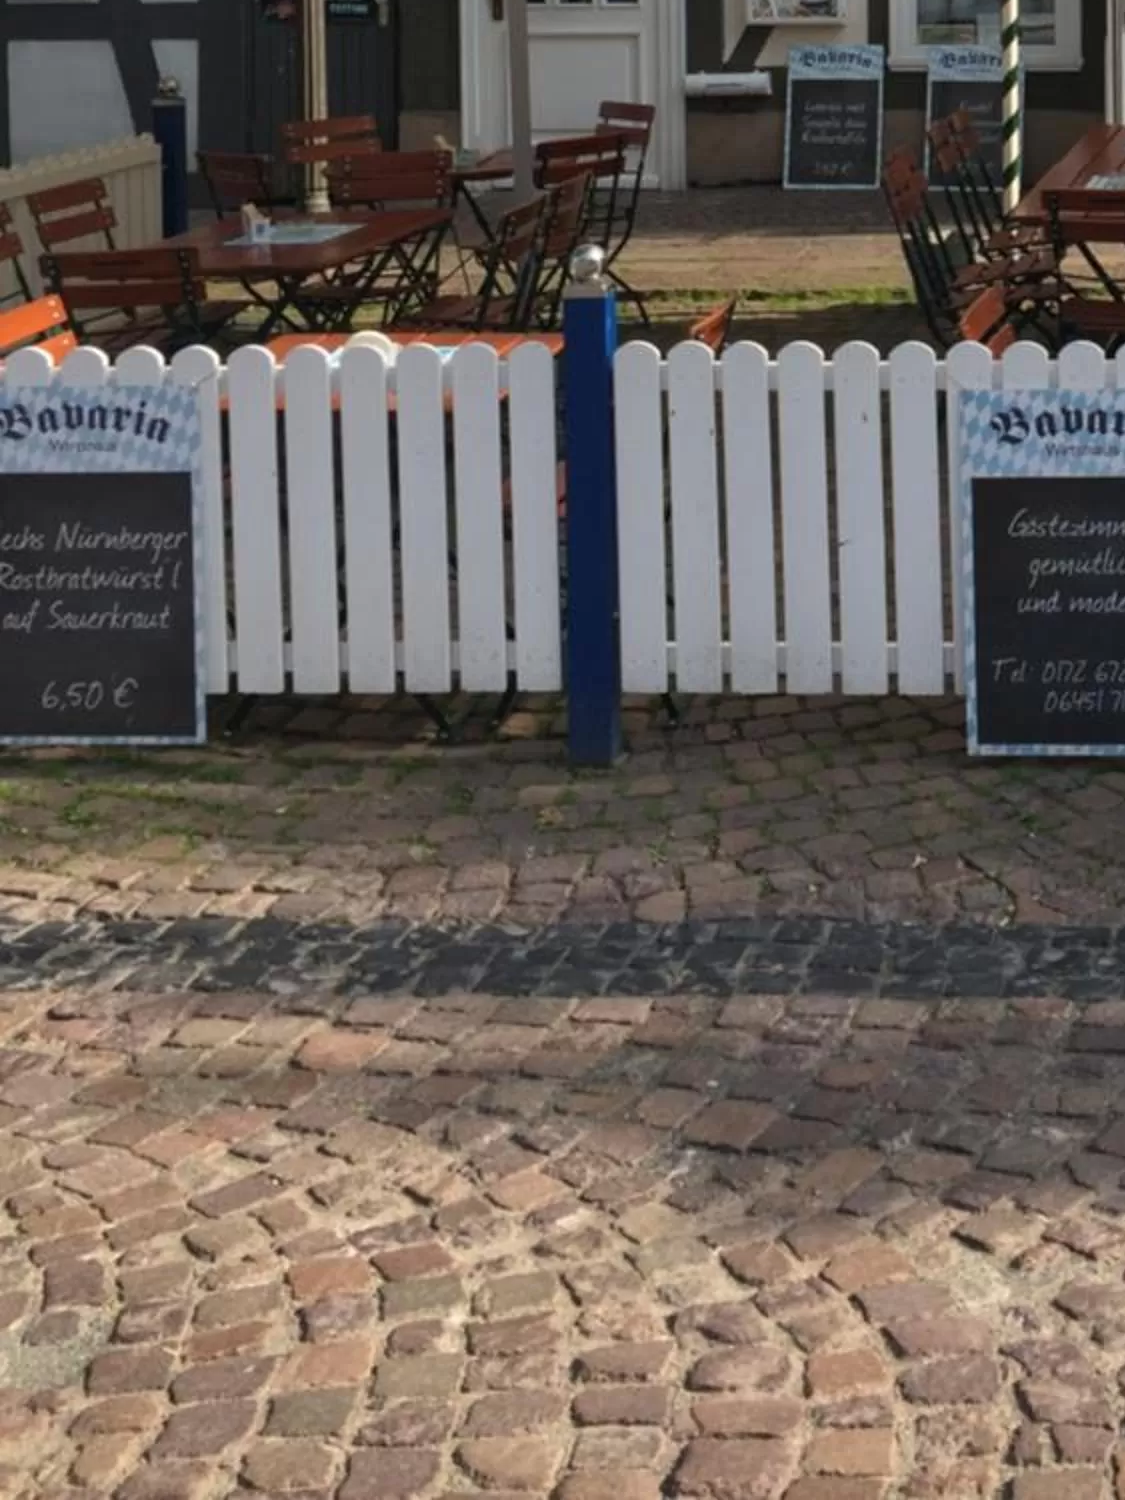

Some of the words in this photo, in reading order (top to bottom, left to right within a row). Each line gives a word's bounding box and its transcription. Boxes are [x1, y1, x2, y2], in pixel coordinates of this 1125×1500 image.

[800, 50, 873, 69] Bavaria
[0, 400, 171, 443] Bavaria
[53, 520, 189, 564] Nürnberger
[3, 598, 40, 634] auf
[44, 599, 171, 630] Sauerkraut
[1017, 590, 1062, 614] und
[41, 680, 104, 711] 6,50
[113, 677, 140, 708] €
